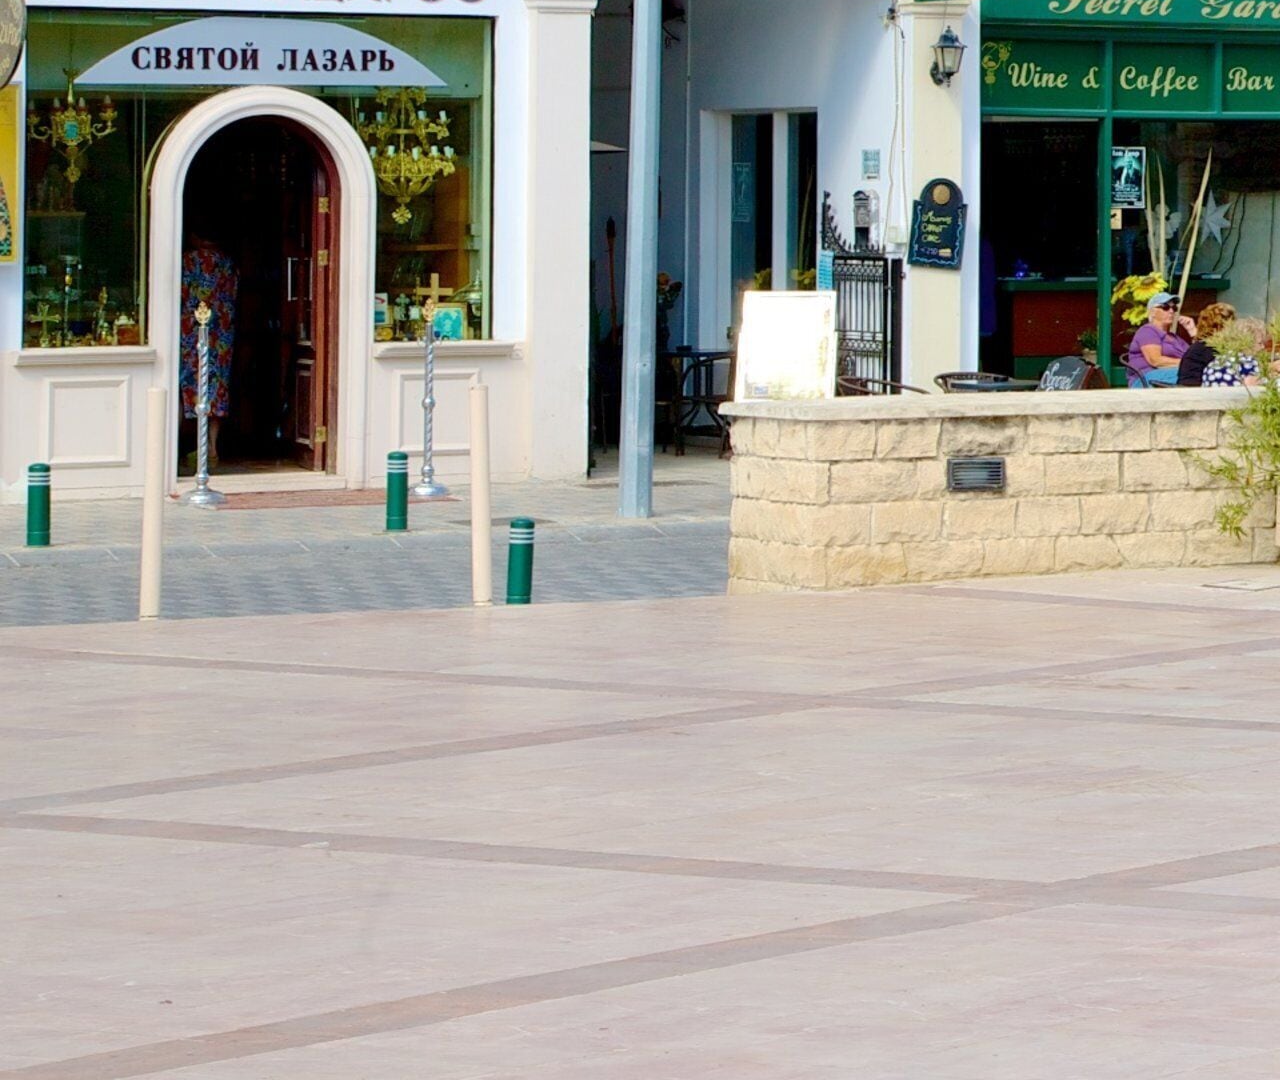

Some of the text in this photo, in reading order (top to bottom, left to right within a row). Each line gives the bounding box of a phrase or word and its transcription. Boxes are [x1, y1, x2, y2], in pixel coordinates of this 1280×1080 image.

[131, 42, 395, 72] СВЯТОЙ ЛАЗАРЬ
[1008, 62, 1275, 98] Wine & Coffee Bar
